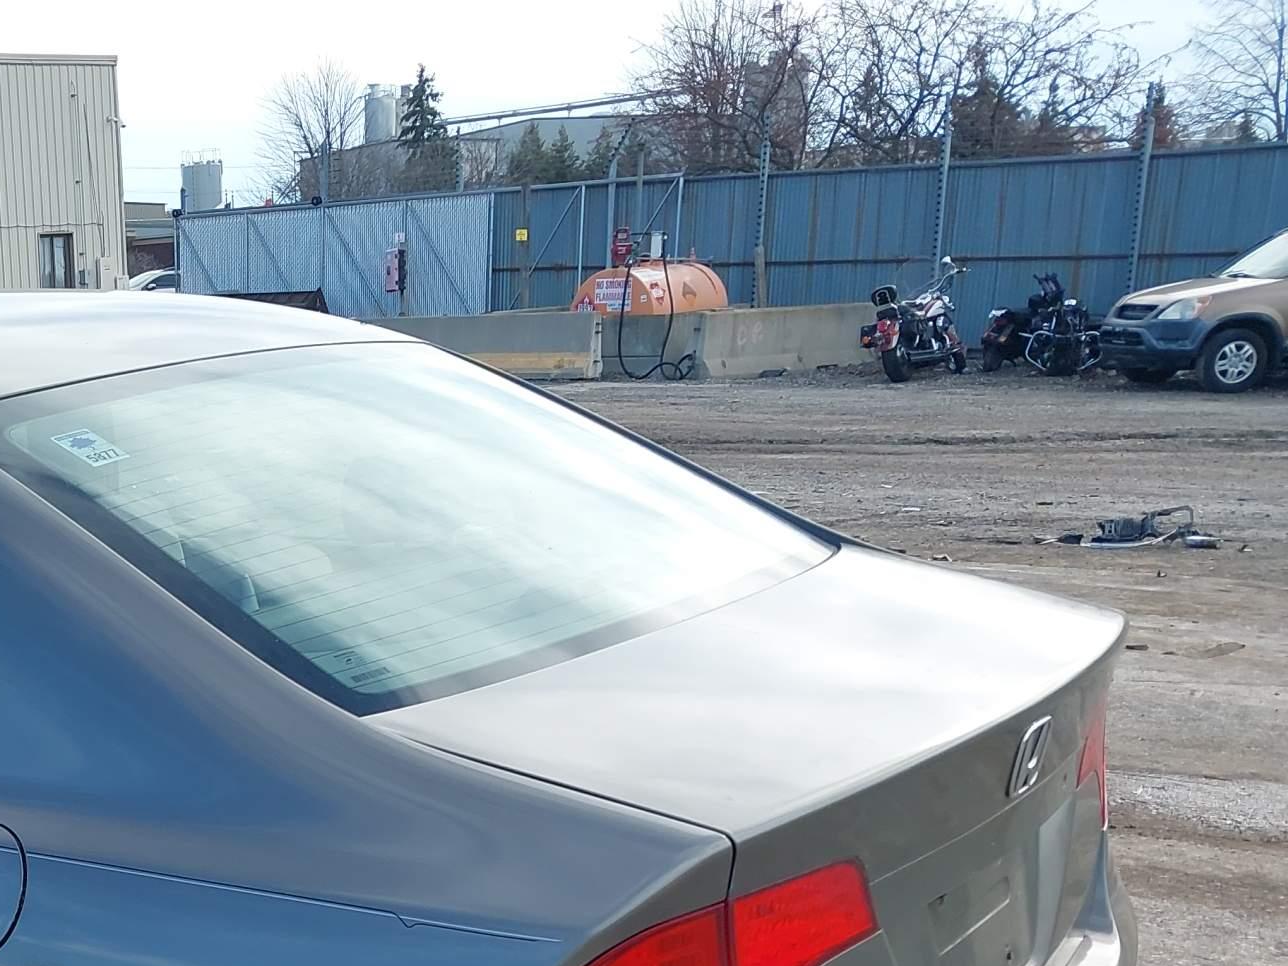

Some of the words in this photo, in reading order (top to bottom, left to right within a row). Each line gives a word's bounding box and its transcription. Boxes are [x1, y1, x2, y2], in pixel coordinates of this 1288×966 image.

[596, 281, 605, 290] NO
[605, 280, 632, 290] SMOKIG
[596, 291, 632, 302] FLAMMABE
